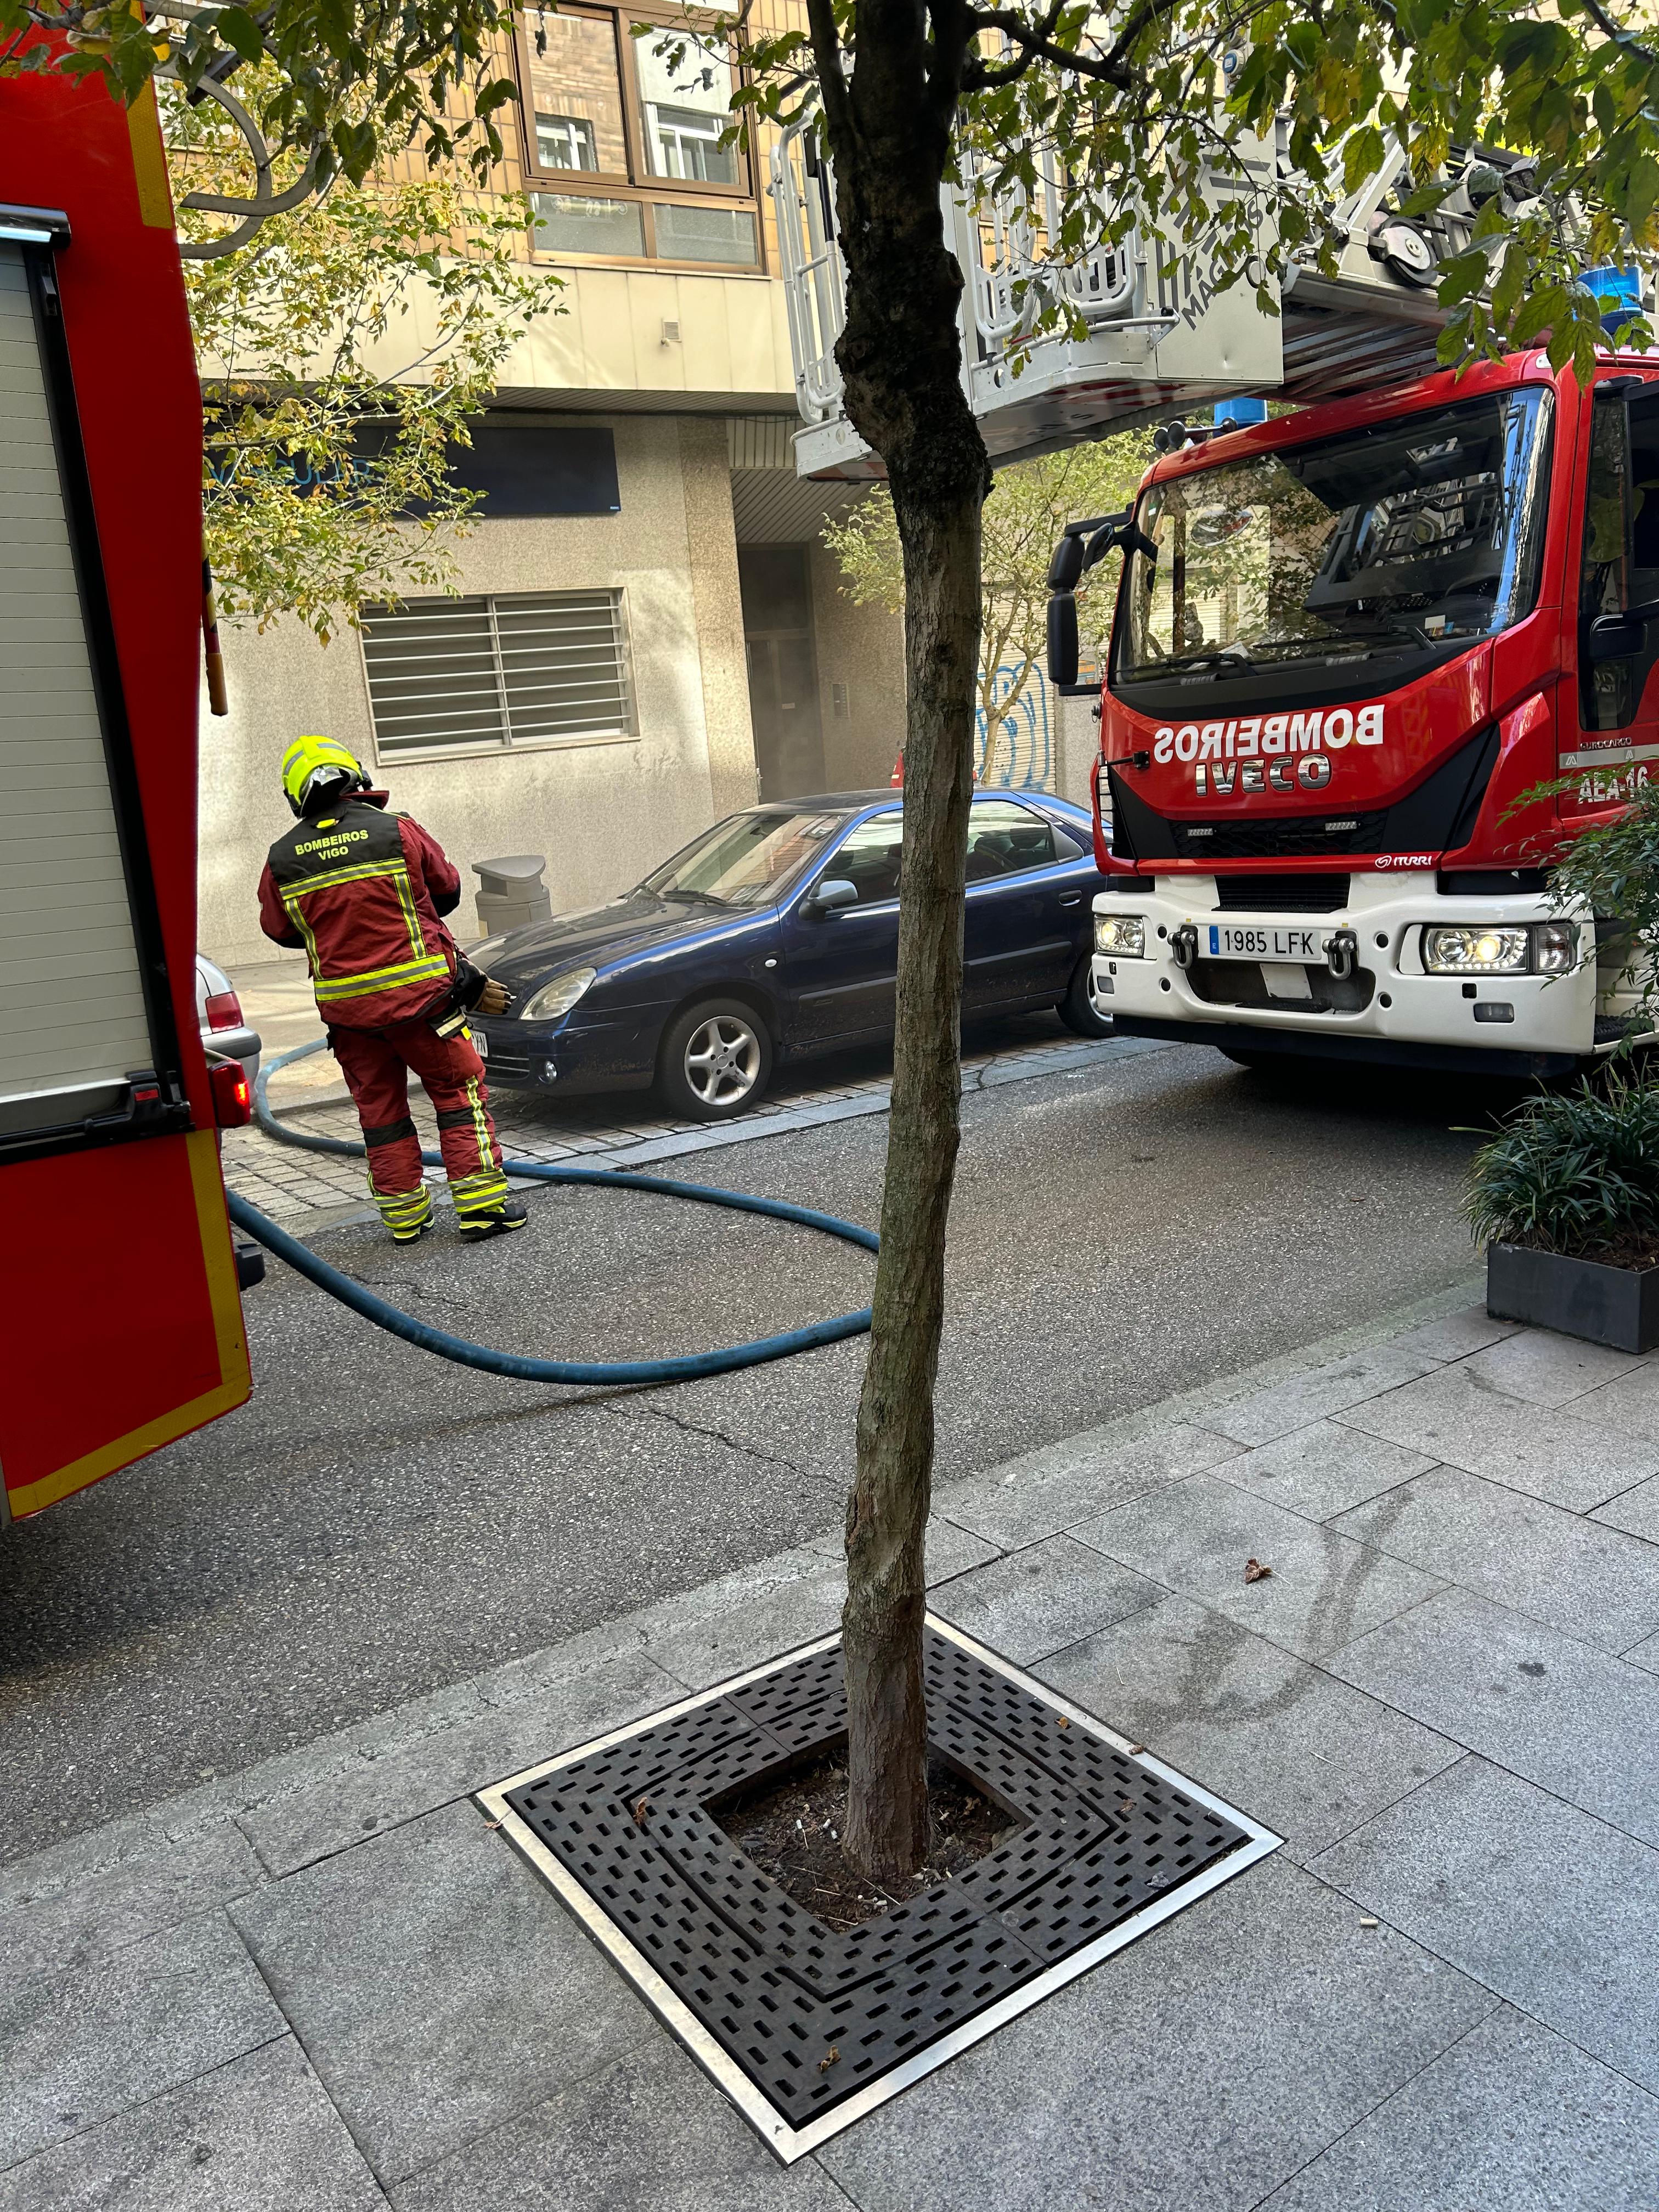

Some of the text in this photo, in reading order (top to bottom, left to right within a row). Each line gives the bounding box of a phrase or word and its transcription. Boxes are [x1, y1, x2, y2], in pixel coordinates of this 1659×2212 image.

[1195, 754, 1331, 797] IVECO
[295, 830, 369, 855] BOMBEIROS
[318, 846, 348, 860] VIGO
[1393, 855, 1432, 866] ITURRI
[1224, 930, 1267, 953] 1985
[1274, 932, 1314, 955] LFK
[472, 1033, 486, 1054] YN
